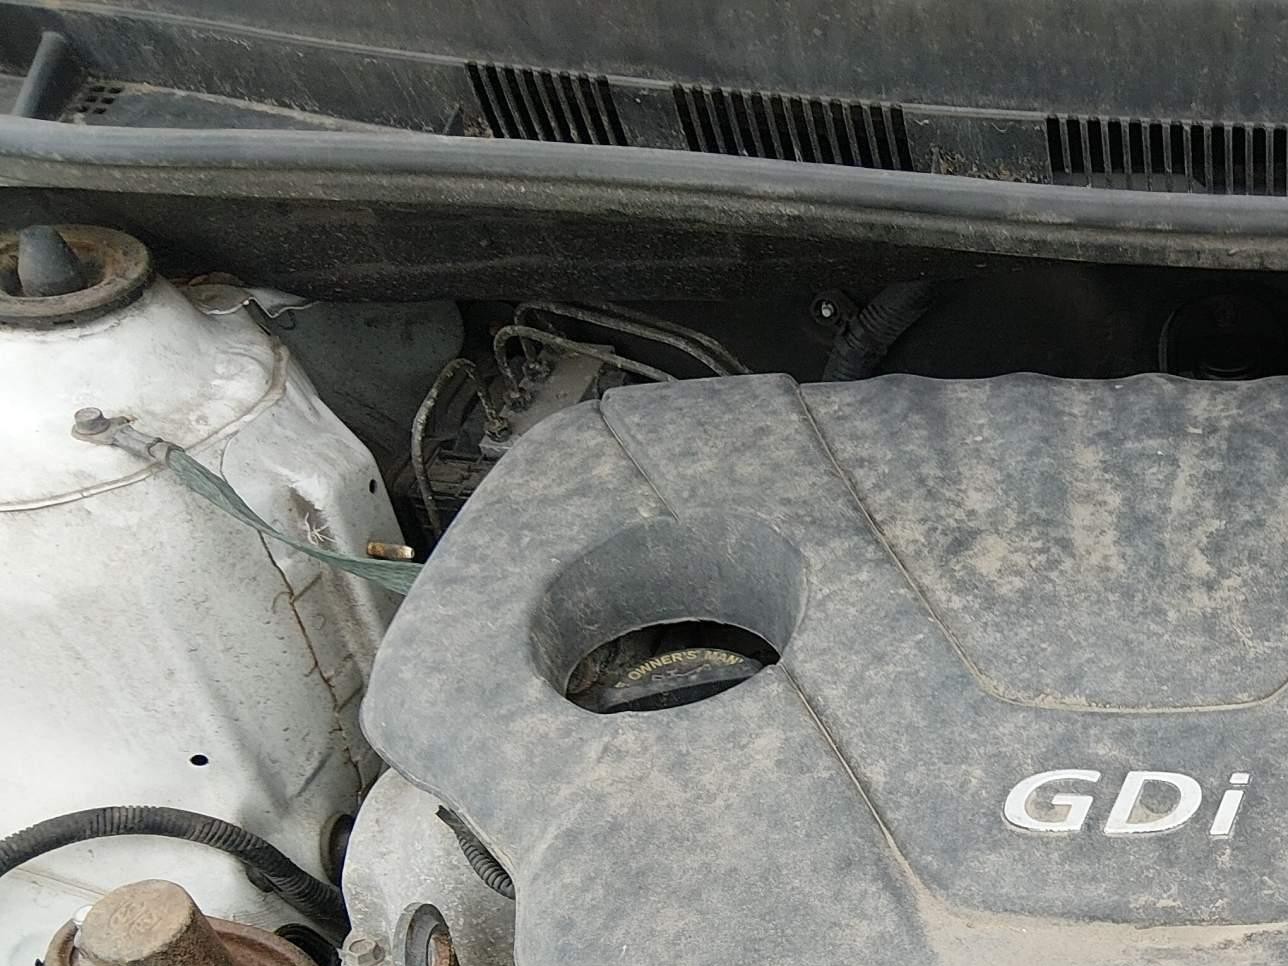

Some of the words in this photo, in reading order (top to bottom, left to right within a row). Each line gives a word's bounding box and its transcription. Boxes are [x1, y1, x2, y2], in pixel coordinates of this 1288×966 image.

[628, 650, 698, 681] OWNER'S
[704, 650, 744, 665] MAN
[1004, 769, 1250, 835] GDi
